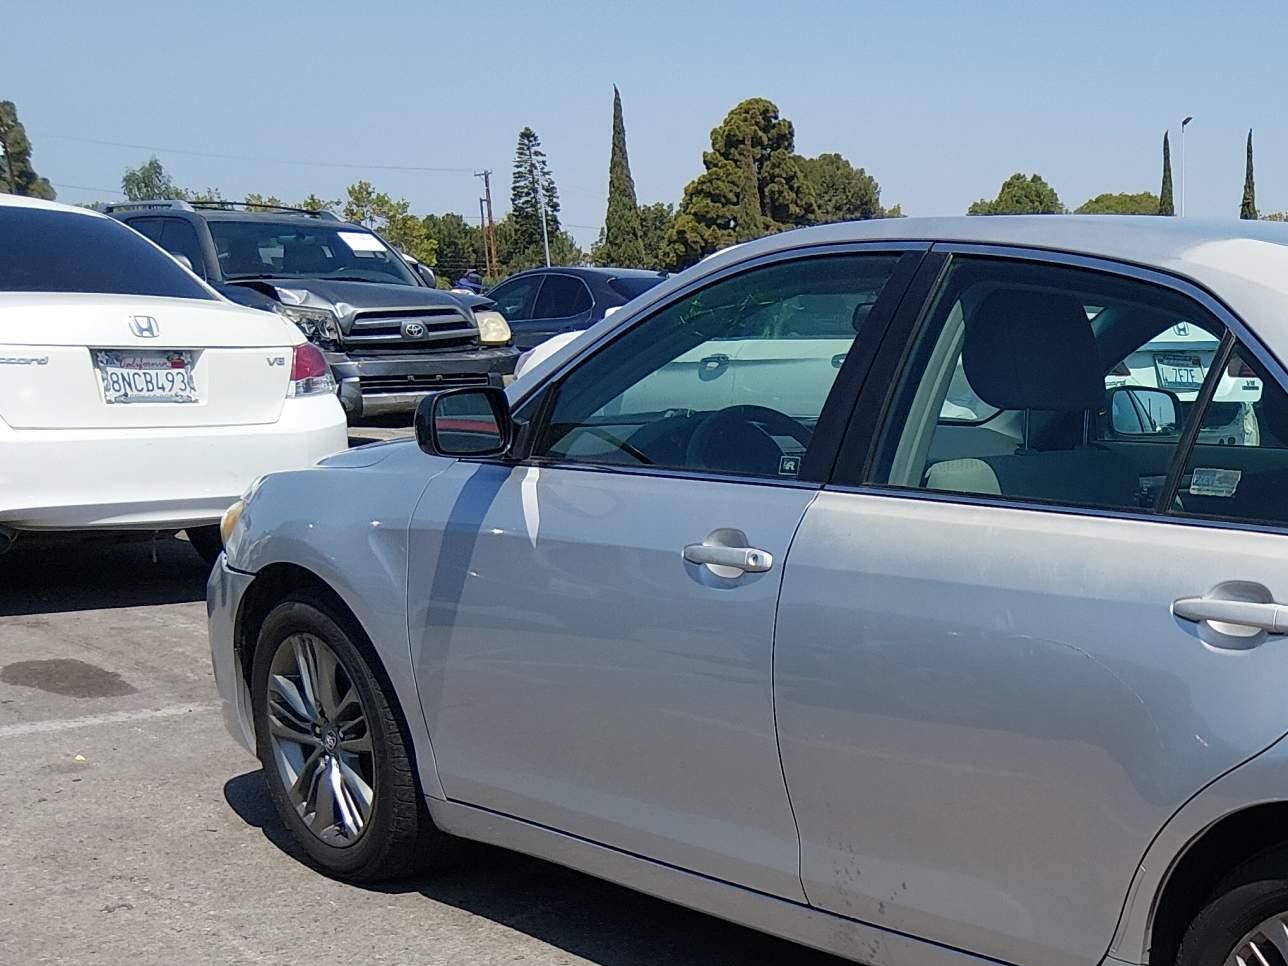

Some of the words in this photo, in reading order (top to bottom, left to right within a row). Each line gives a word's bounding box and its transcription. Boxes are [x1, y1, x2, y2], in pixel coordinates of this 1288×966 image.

[0, 354, 49, 365] ccord
[119, 357, 169, 370] California
[266, 357, 285, 367] V6
[109, 371, 187, 393] 8NCB493
